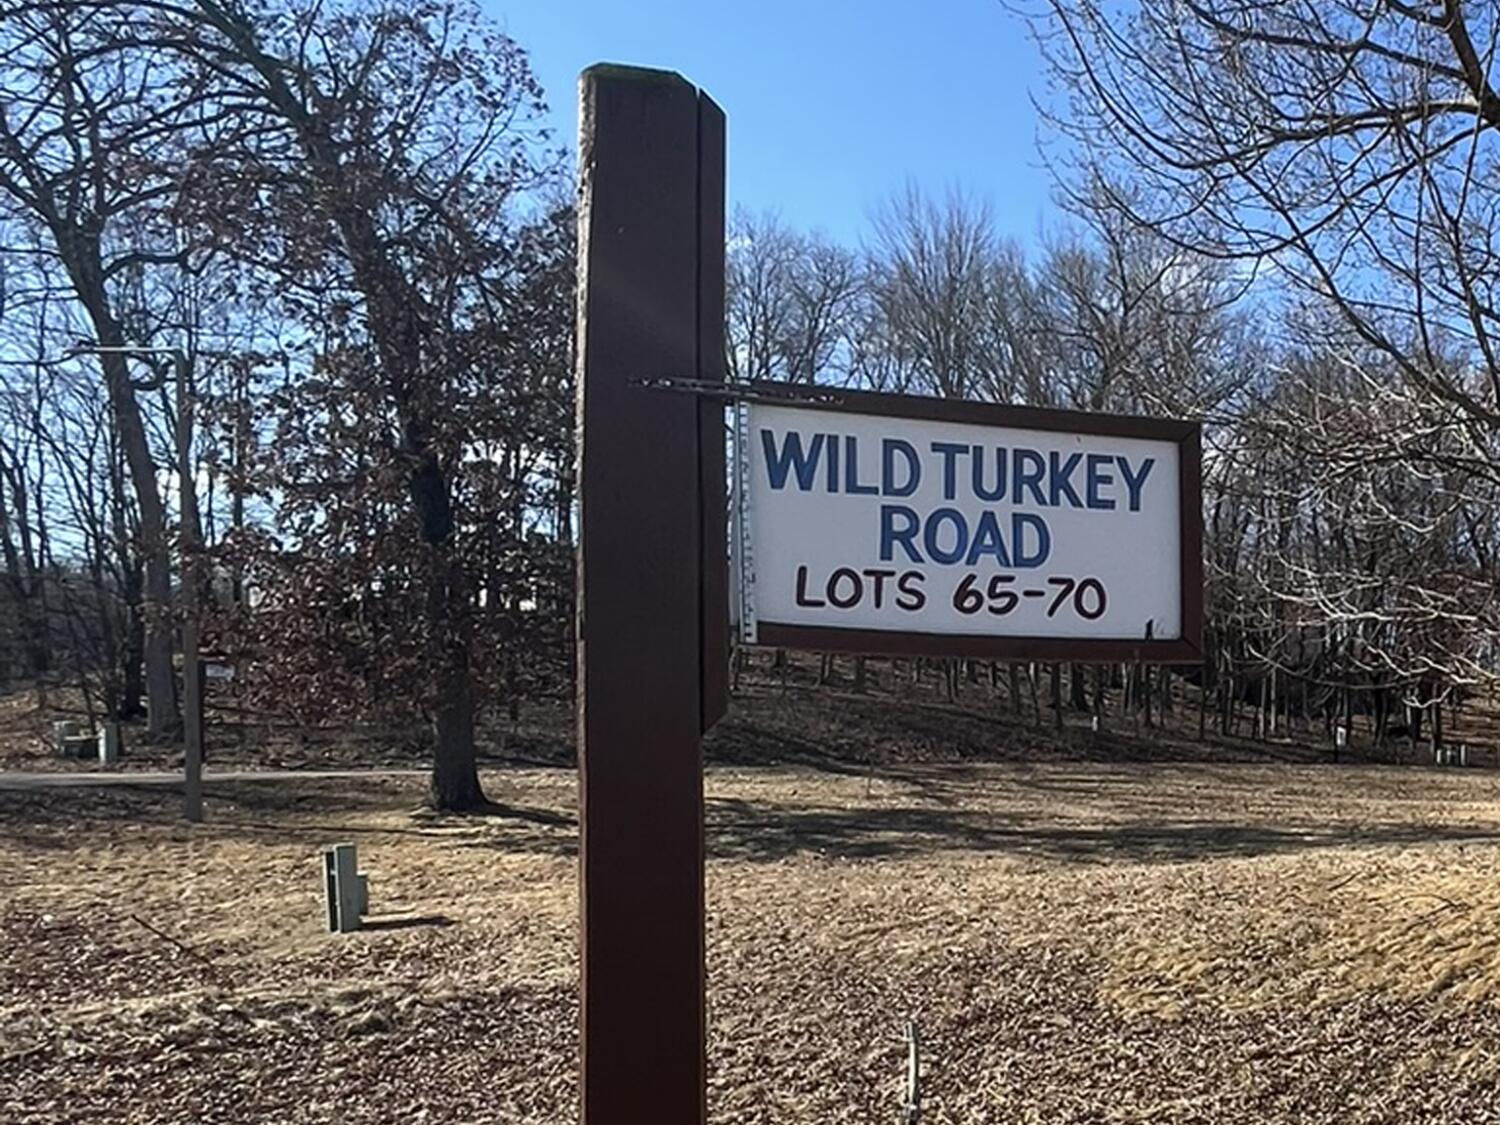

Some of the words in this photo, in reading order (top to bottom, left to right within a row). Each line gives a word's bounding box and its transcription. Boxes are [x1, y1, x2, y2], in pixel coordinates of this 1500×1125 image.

[760, 429, 921, 497] WILD
[931, 442, 1155, 511] TURKEY
[879, 505, 1051, 568] ROAD
[795, 566, 926, 611] LOTS
[952, 573, 1107, 619] 65-70
